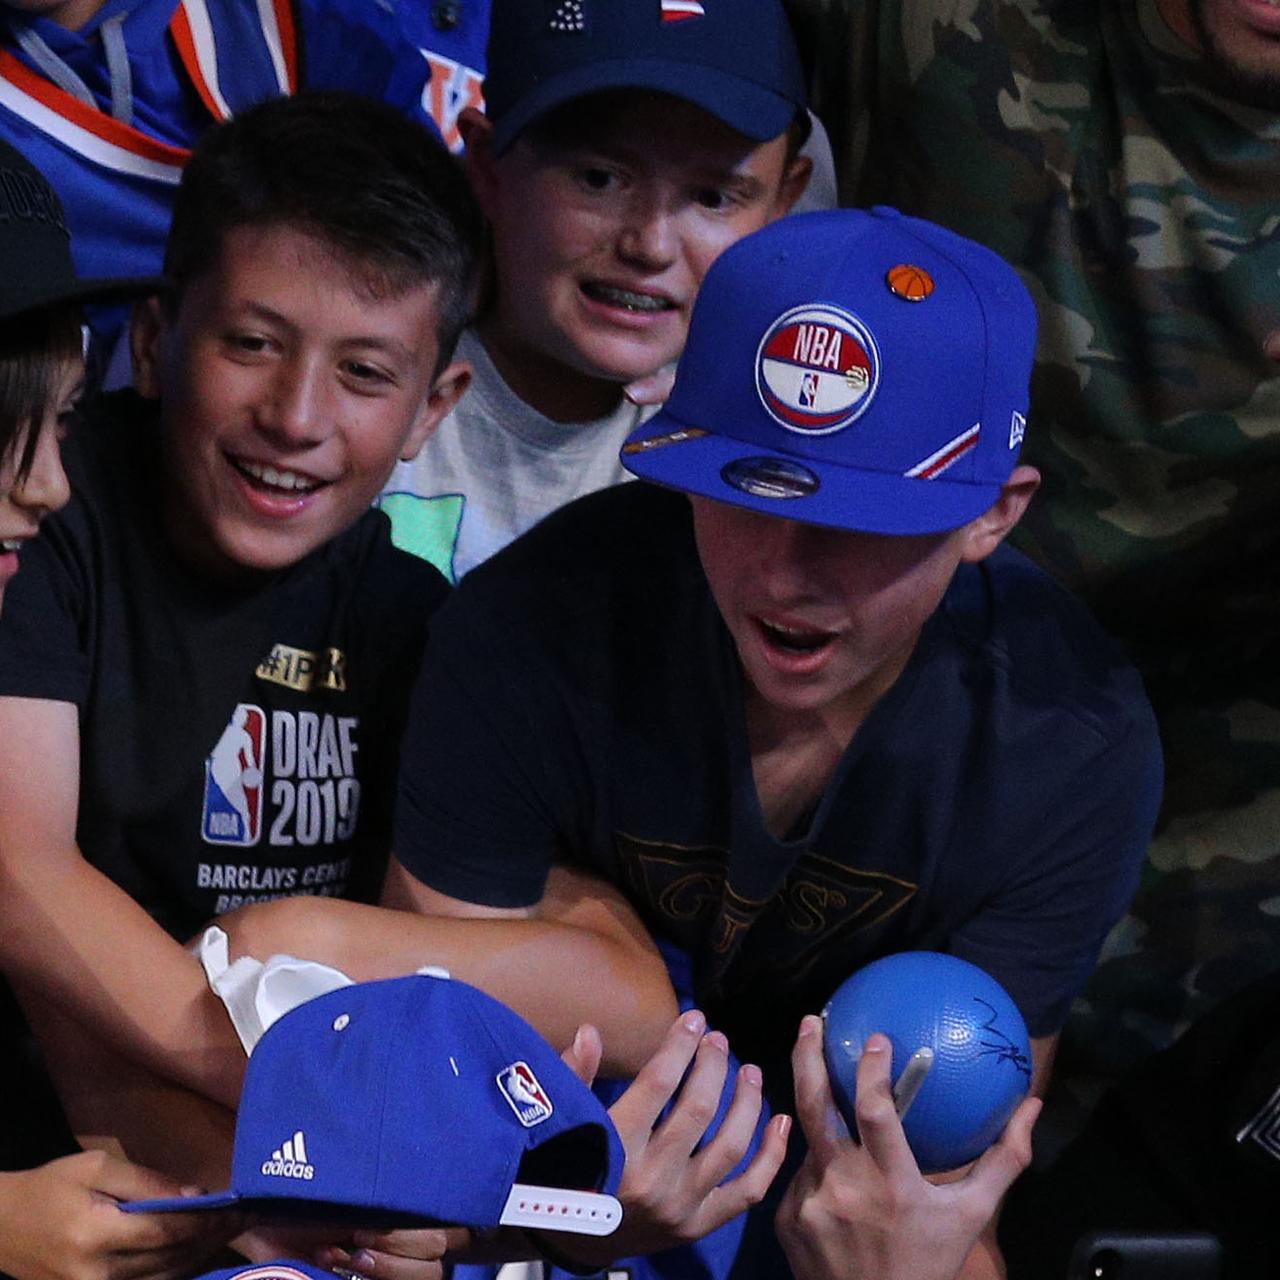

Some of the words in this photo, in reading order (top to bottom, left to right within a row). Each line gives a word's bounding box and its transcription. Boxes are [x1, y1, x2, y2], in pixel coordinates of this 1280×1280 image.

[793, 324, 844, 370] NBA
[258, 647, 345, 689] #1PK
[272, 711, 360, 778] DRAF
[209, 812, 240, 837] NBA
[270, 777, 361, 847] 2019
[197, 862, 297, 889] BARCLAYS
[301, 857, 351, 886] CENT
[261, 1158, 314, 1181] adidas
